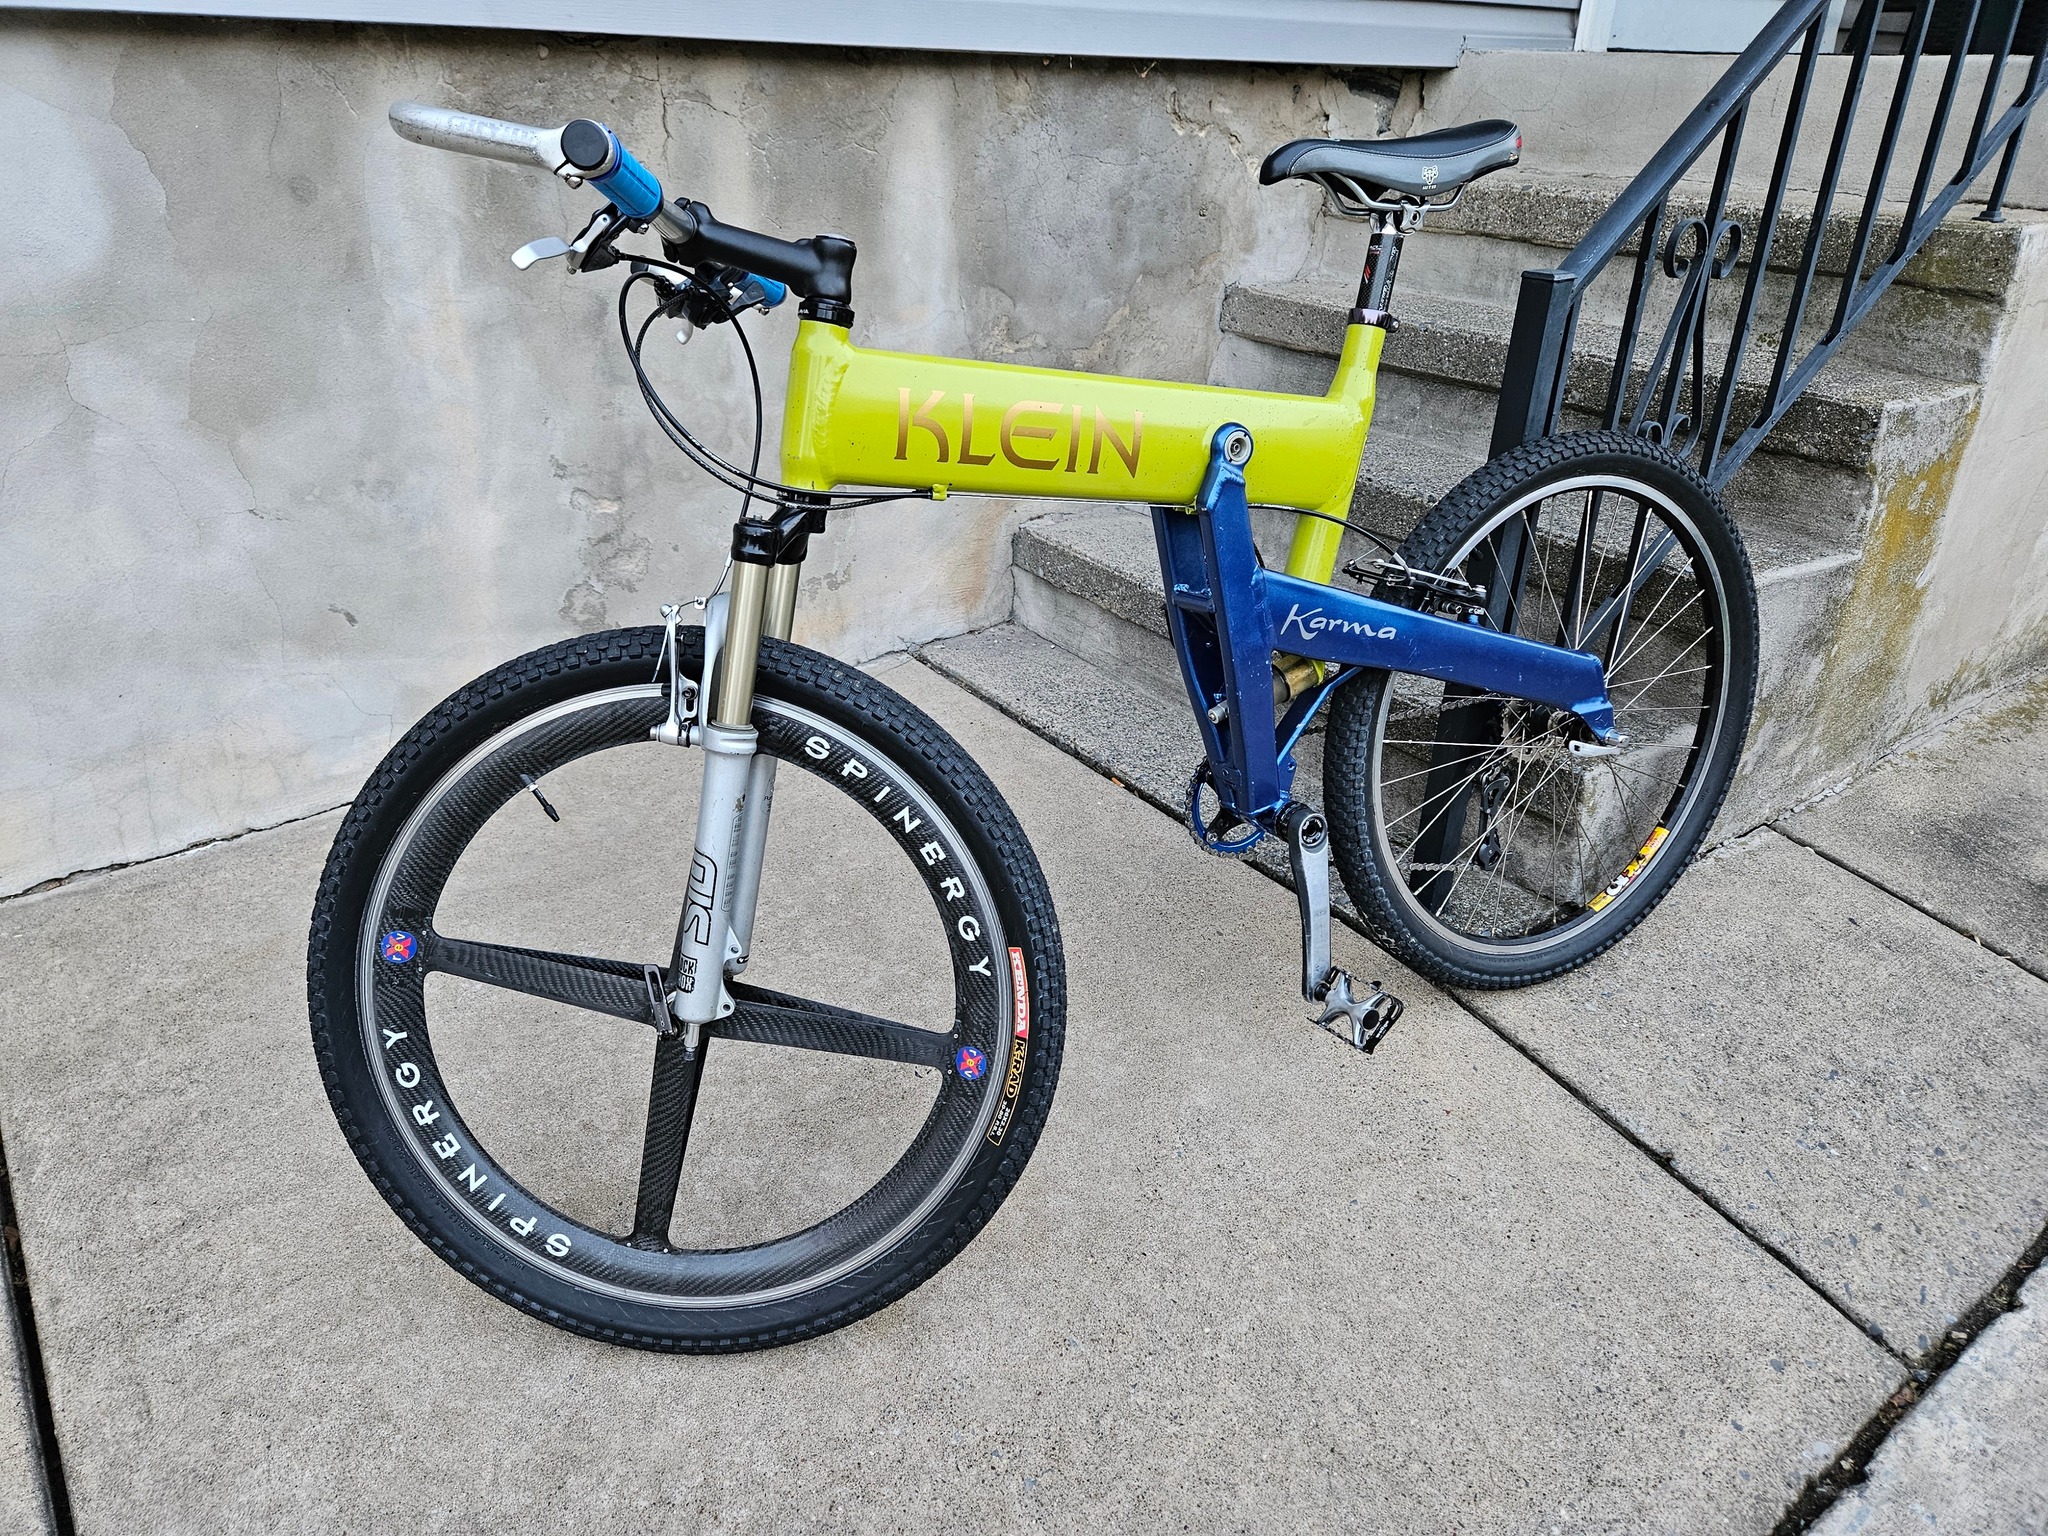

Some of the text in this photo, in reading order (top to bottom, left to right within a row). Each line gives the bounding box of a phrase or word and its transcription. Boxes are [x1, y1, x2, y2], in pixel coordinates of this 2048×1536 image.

[893, 387, 1146, 478] KLEIN
[1279, 603, 1398, 642] Karma
[804, 736, 992, 978] SPINERGY
[1012, 952, 1027, 1032] KENDA
[1006, 1040, 1026, 1098] K-RAD
[383, 1027, 573, 1259] SPINERGY
